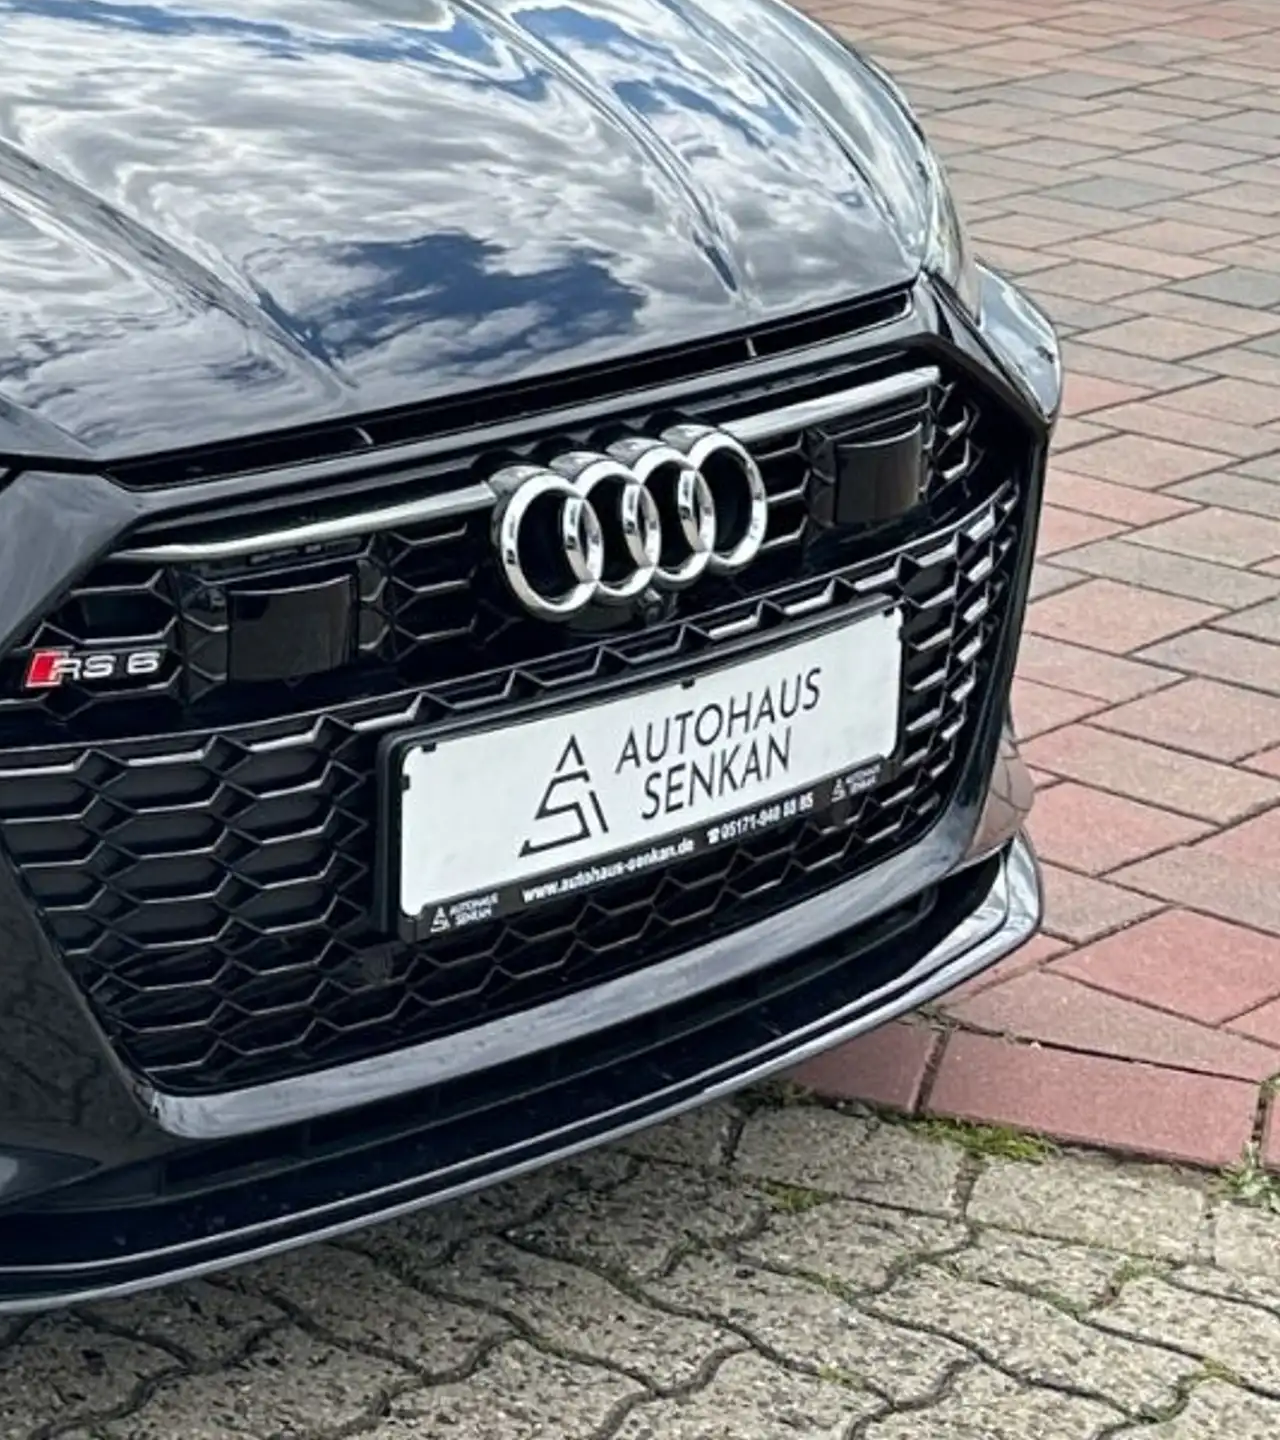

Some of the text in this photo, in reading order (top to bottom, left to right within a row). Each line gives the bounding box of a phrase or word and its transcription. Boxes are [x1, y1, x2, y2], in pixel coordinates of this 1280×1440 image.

[614, 666, 822, 775] AUTOHAUS
[640, 726, 792, 821] SENKAN
[521, 836, 695, 904] www.autohaus-senkan.de
